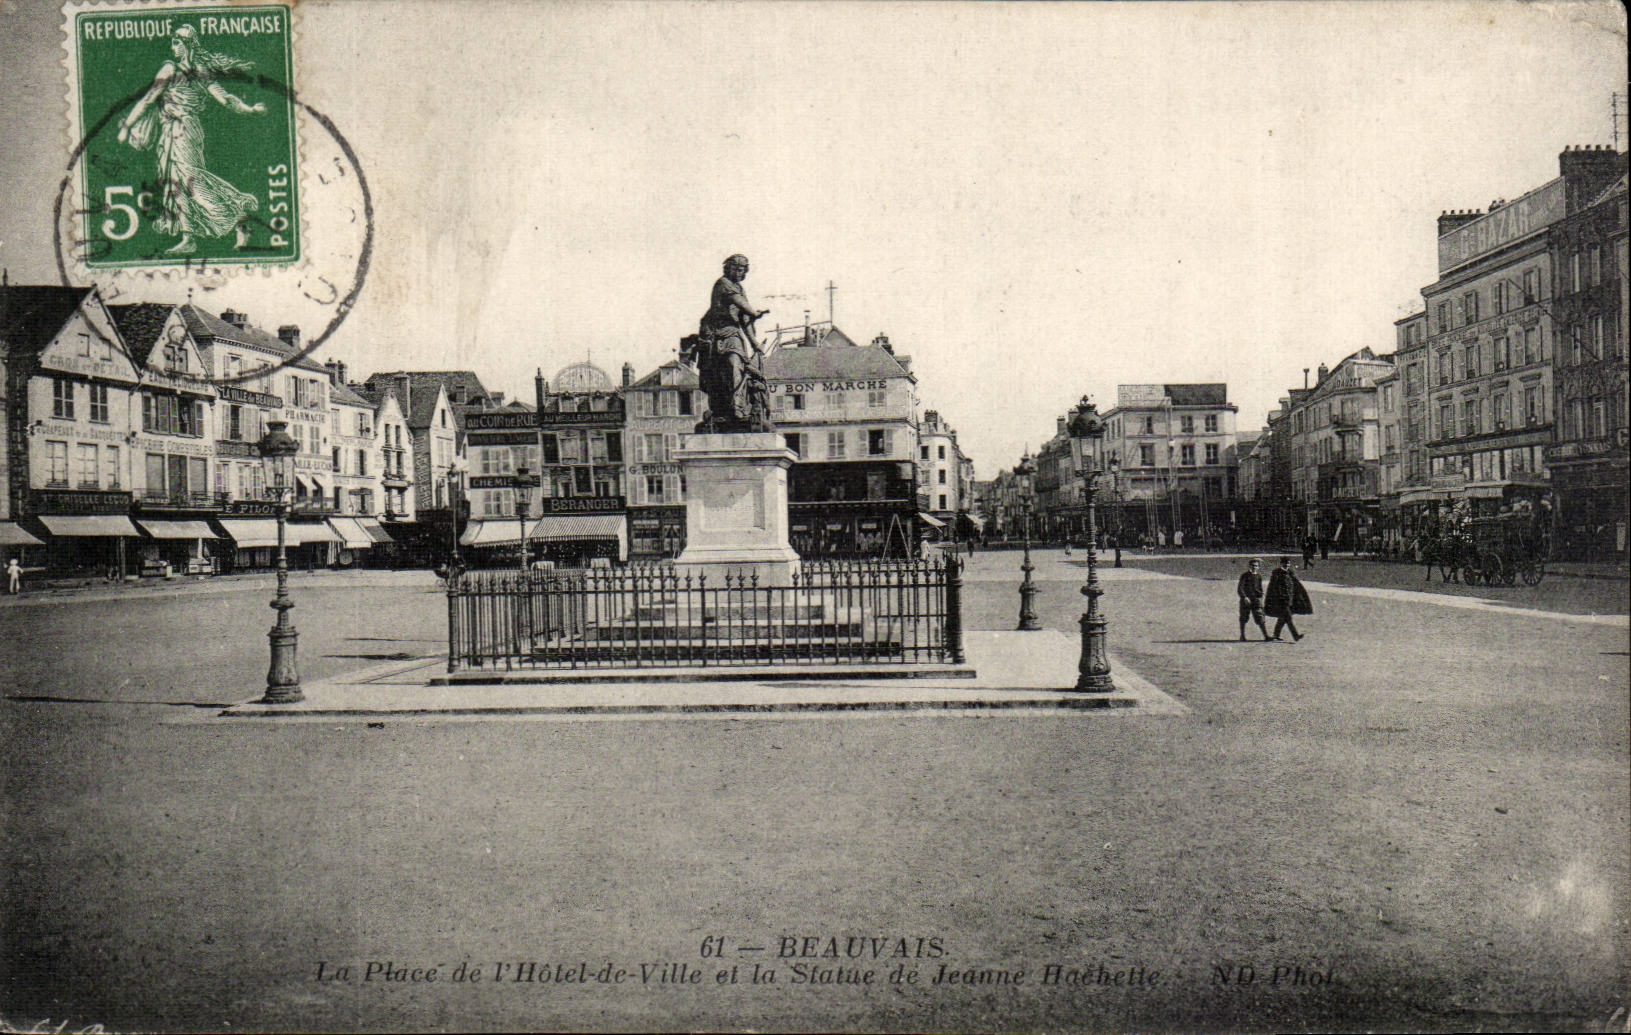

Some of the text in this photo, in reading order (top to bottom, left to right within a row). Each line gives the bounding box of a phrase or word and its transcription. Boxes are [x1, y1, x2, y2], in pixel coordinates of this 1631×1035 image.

[200, 15, 281, 37] FRANÇAISE
[268, 164, 289, 247] POSTES
[786, 383, 815, 393] BON
[285, 409, 326, 424] PHARMACIE
[479, 415, 504, 428] COIN
[516, 413, 538, 427] RUE
[240, 504, 276, 513] PILO
[551, 498, 620, 511] BERANGER
